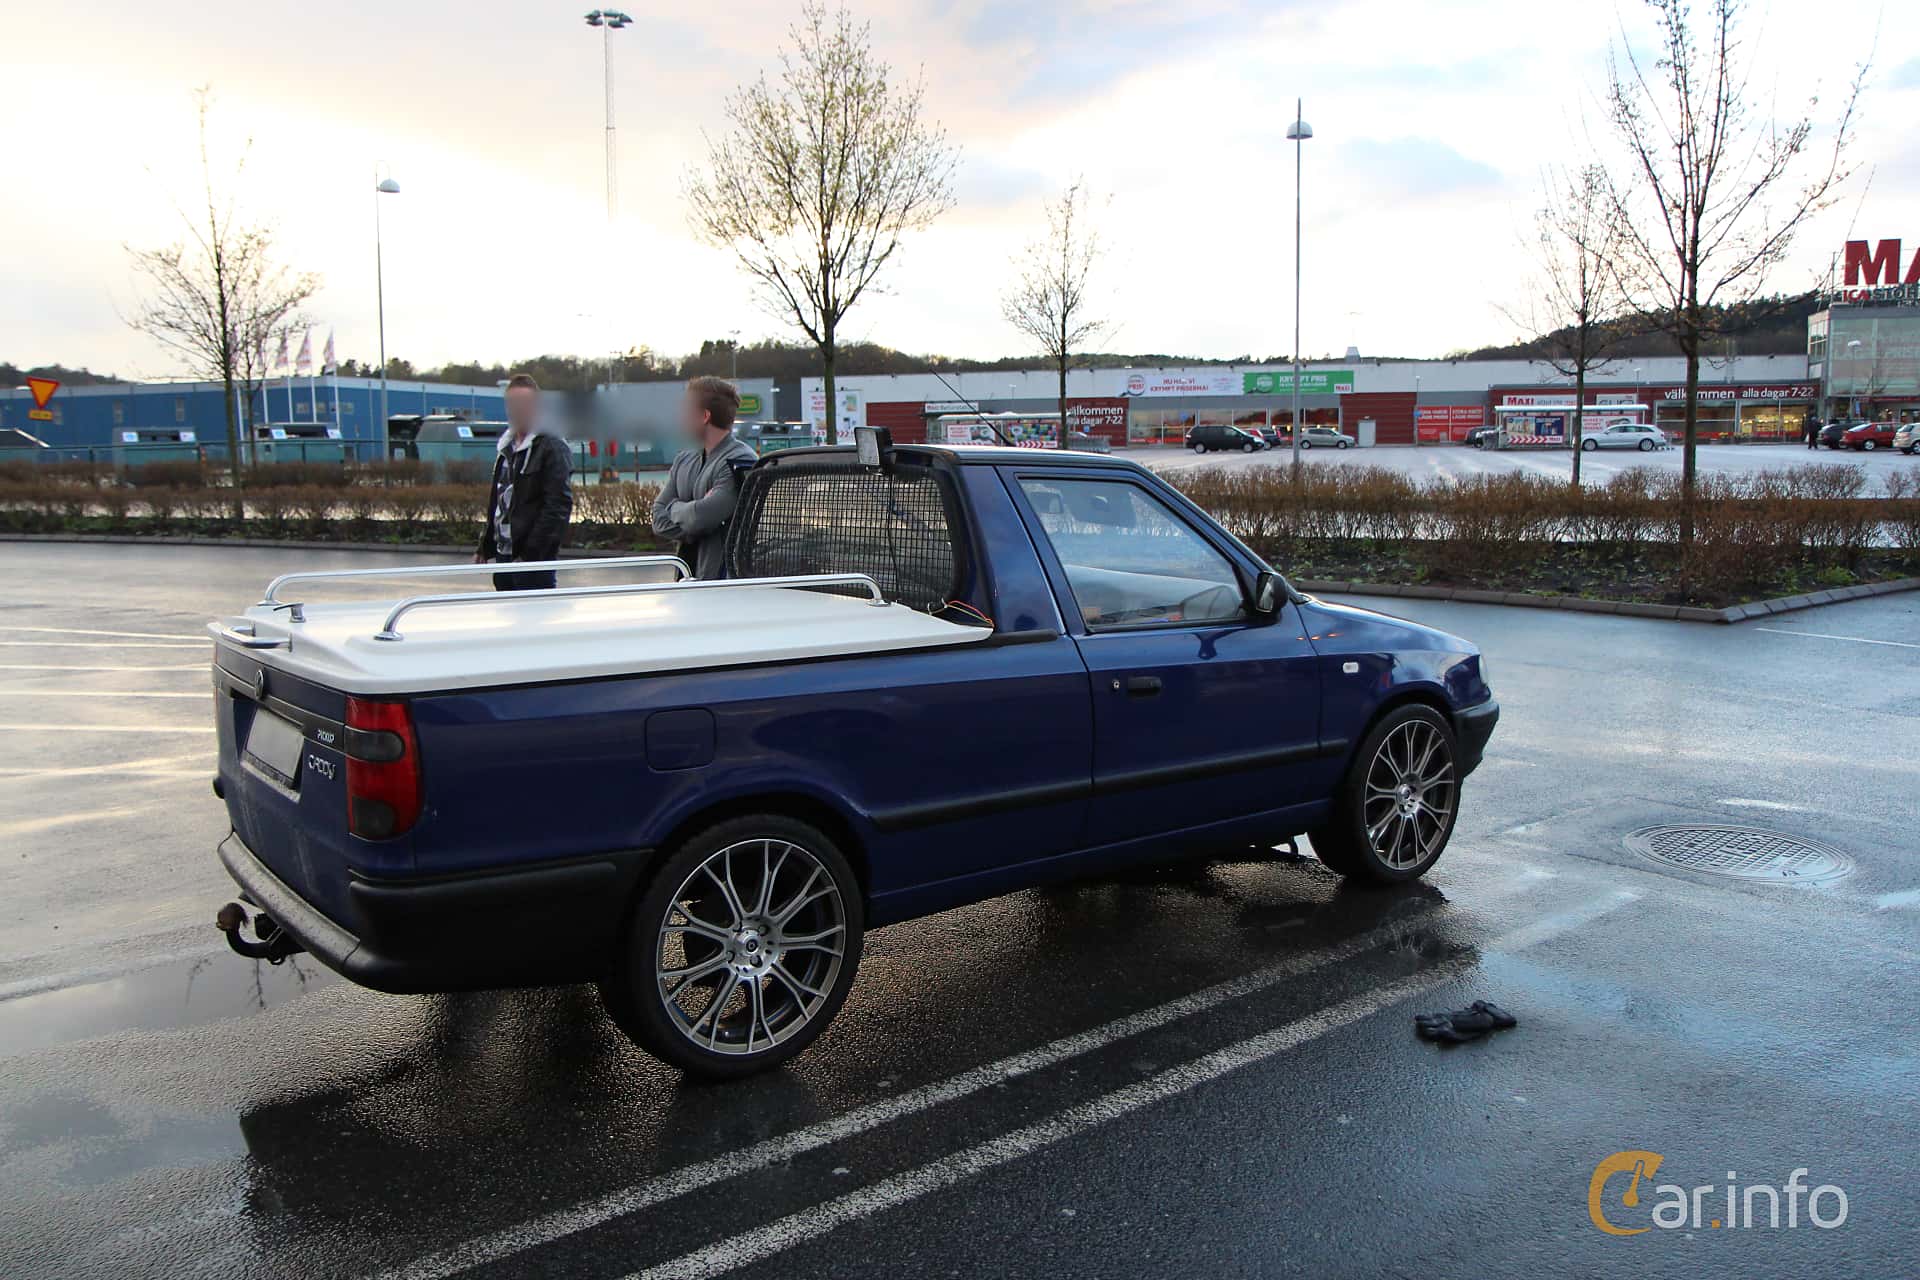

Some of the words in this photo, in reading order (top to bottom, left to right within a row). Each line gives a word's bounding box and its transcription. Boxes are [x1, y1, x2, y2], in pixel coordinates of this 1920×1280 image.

[1843, 289, 1870, 302] ICA
[1665, 389, 1735, 400] välkmmen
[1742, 388, 1759, 398] alla
[1761, 388, 1789, 400] dagar
[1791, 387, 1814, 397] 7-22
[1081, 416, 1103, 427] dagar
